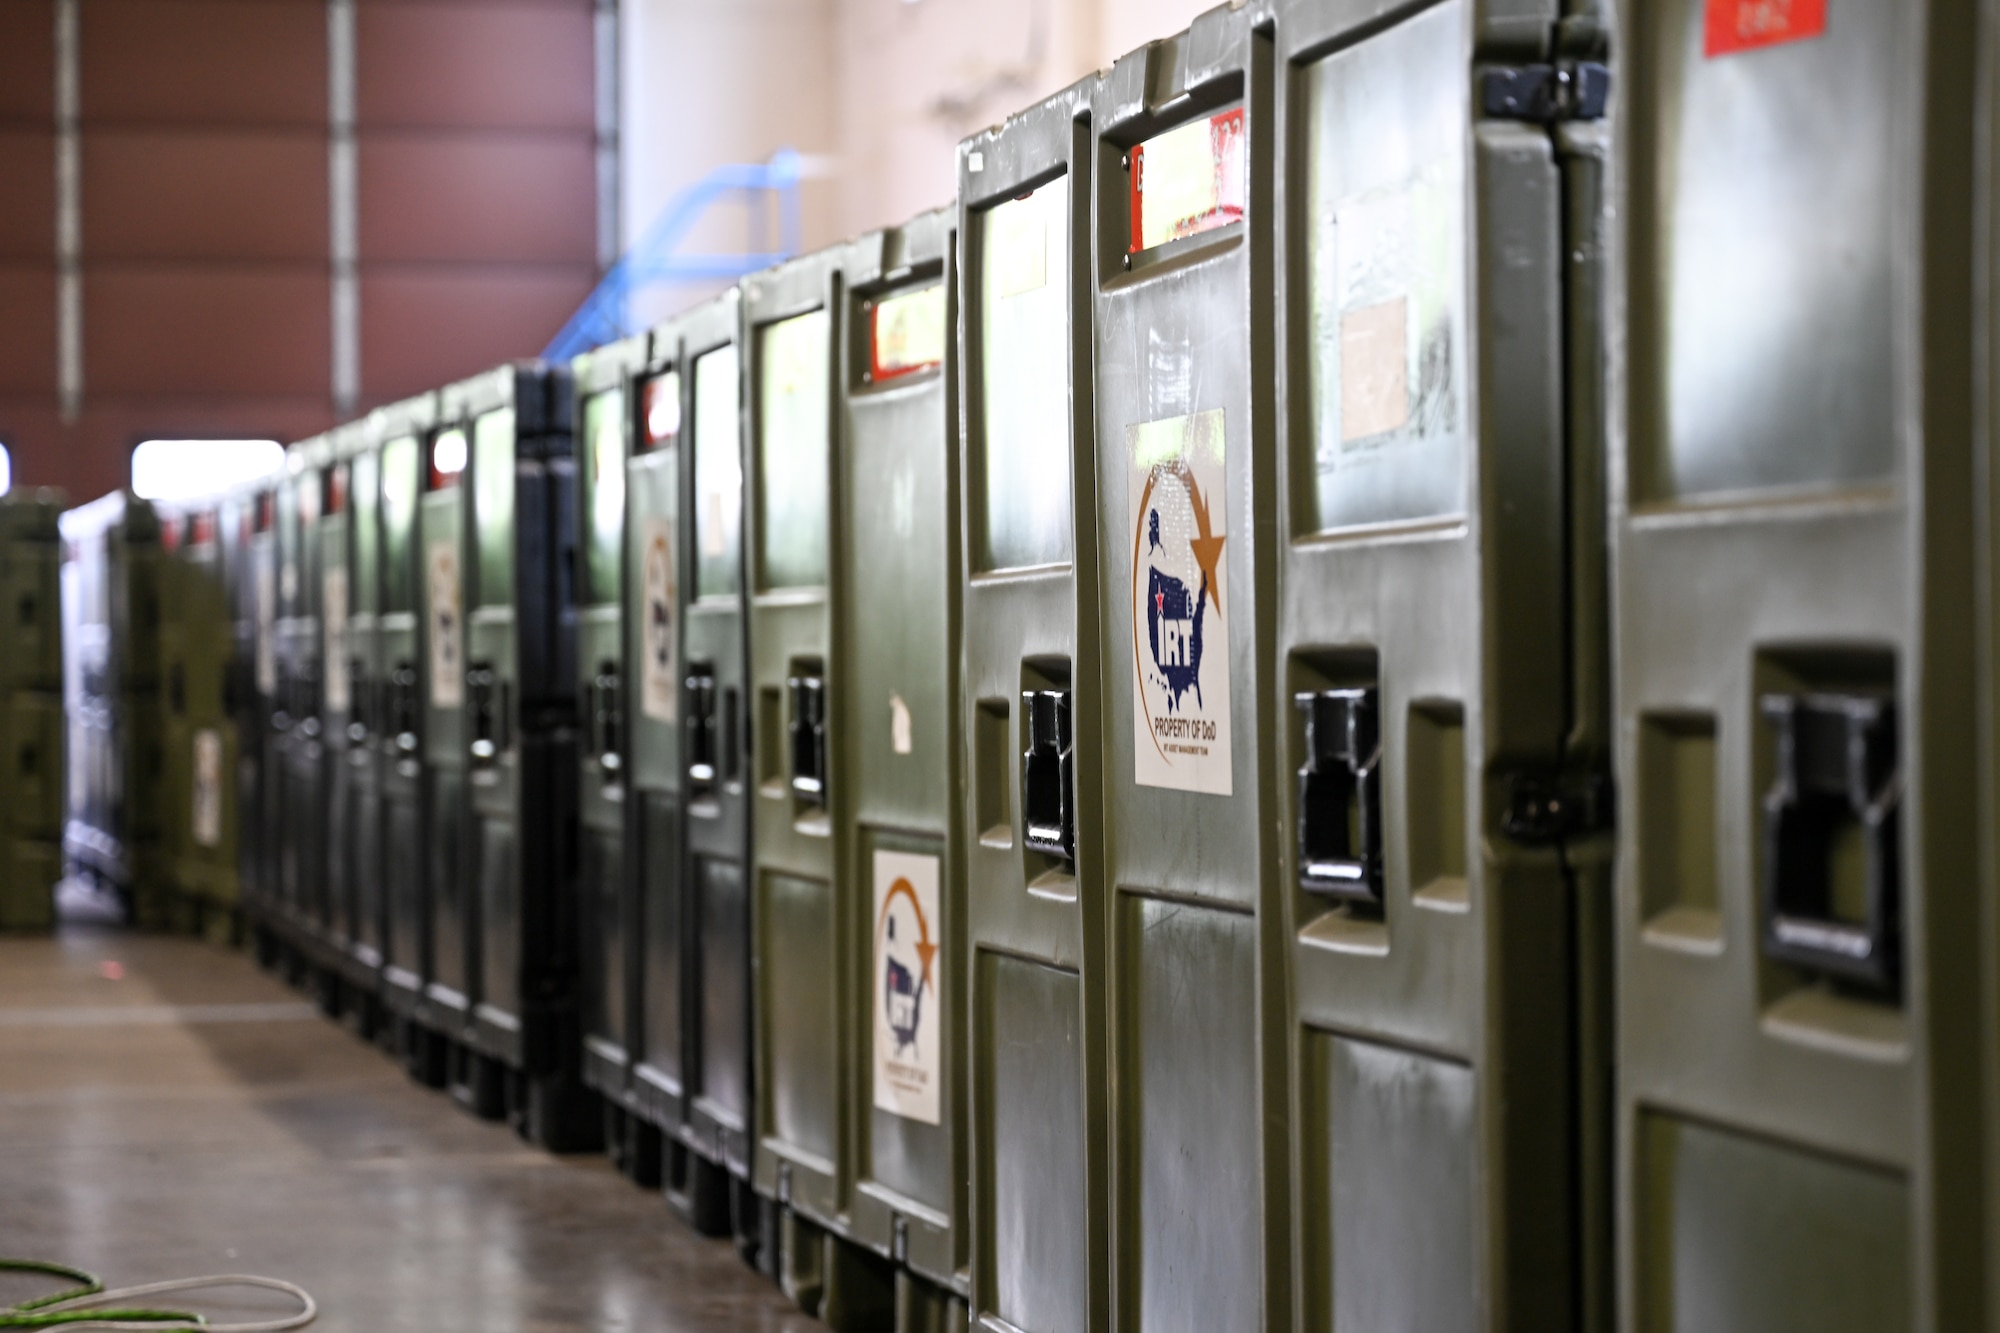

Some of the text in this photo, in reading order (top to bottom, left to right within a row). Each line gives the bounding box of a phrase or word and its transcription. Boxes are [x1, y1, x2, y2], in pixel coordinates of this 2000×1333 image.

[1157, 612, 1193, 667] IRT
[1155, 717, 1216, 741] PROPERTY OF DoD
